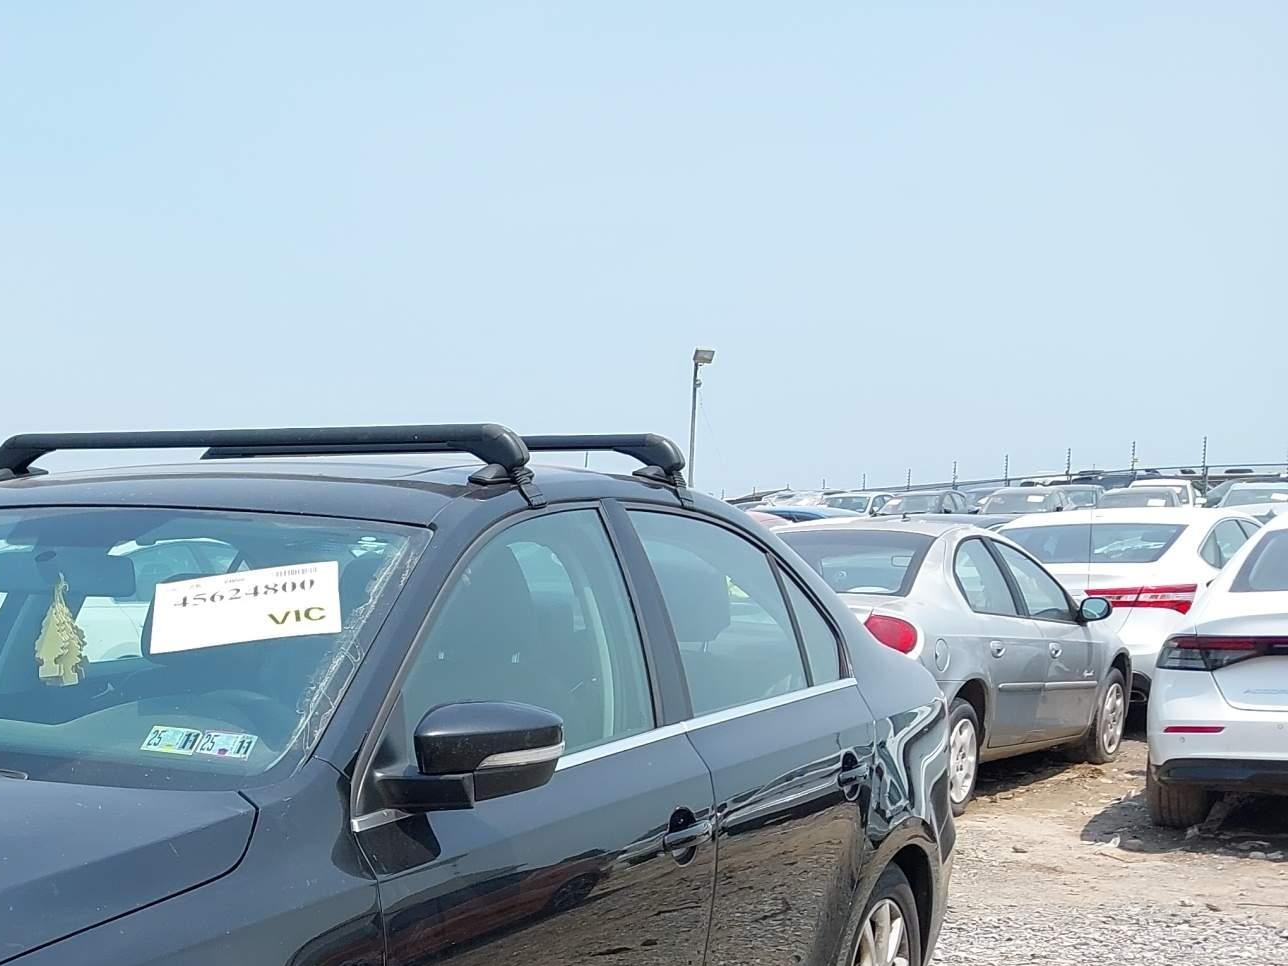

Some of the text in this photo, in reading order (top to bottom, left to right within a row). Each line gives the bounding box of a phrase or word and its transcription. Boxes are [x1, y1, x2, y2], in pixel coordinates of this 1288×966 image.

[173, 578, 315, 608] 45624800
[267, 606, 327, 625] VIC
[147, 729, 201, 750] 25 11
[199, 733, 253, 755] 25 11
